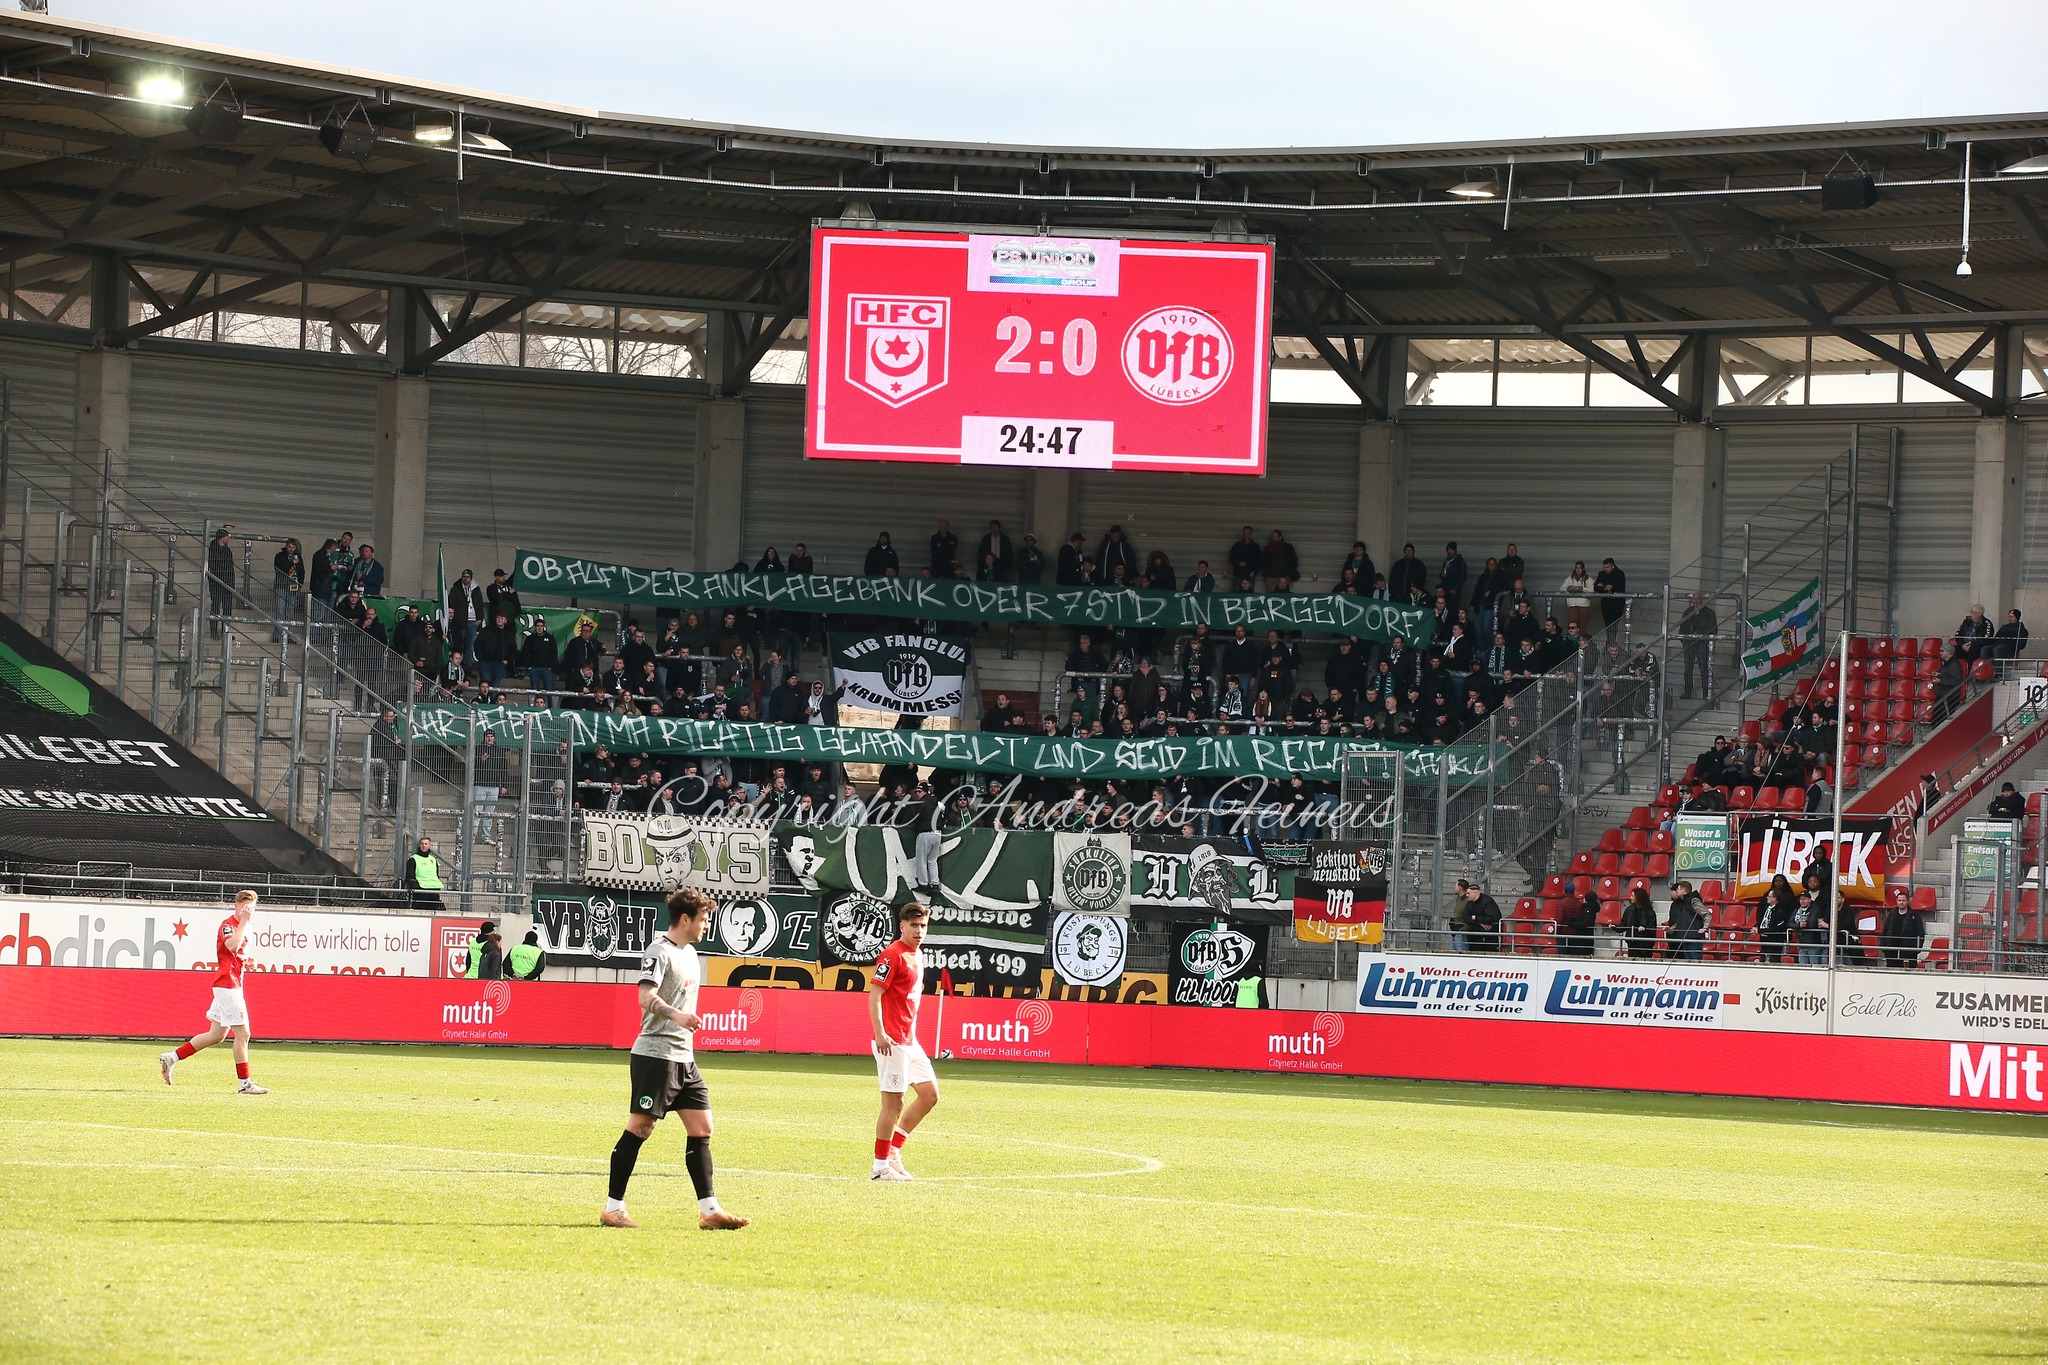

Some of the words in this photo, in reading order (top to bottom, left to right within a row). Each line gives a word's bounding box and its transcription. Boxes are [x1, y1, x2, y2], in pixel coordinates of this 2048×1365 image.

[996, 251, 1022, 262] PS
[1027, 252, 1089, 265] UNION
[860, 303, 937, 324] HFC
[1161, 315, 1197, 326] 1919
[995, 315, 1097, 376] 2:0
[1150, 384, 1201, 399] LÜBECK
[1000, 424, 1082, 454] 24:47
[522, 556, 563, 581] OB
[565, 560, 616, 589] AUF
[622, 566, 700, 599] DER
[703, 573, 946, 608] ANKLAGEBANK
[953, 582, 1054, 621] ODER
[1174, 592, 1212, 626] IN
[843, 638, 880, 659] VfB
[0, 734, 180, 767] ILEBET
[657, 717, 805, 754] RICHTIG
[813, 727, 1029, 766] GEHANDELT
[1034, 741, 1106, 773] UND
[1114, 737, 1188, 773] SEID
[1196, 737, 1241, 771] IM
[33, 789, 267, 818] SPORTWETTE.
[1680, 838, 1726, 849] Entsorgung
[1684, 829, 1714, 838] Wasser
[1715, 829, 1721, 838] &
[928, 903, 1032, 929] rontside
[1307, 914, 1368, 940] LÜBECK
[314, 927, 377, 951] wirklich
[384, 930, 420, 952] tolle
[921, 947, 982, 972] übeck
[1420, 966, 1528, 980] Wohn-Centrum
[1607, 974, 1719, 987] Wohn-Centrum
[1360, 962, 1529, 1009] Lührmann
[1544, 969, 1720, 1016] Lührmann
[442, 1001, 493, 1024] muth
[1446, 1002, 1471, 1011] der
[1474, 1003, 1523, 1013] Saline
[1755, 986, 1827, 1016] Köstritze
[1841, 993, 1883, 1018] Edel
[1879, 993, 1918, 1018] Pils
[1936, 991, 2048, 1014] ZUSAMME
[702, 1009, 747, 1031] muth
[1634, 1010, 1660, 1019] der
[1663, 1011, 1714, 1022] Saline
[1962, 1015, 2011, 1029] WIRD'S
[441, 1028, 468, 1040] Citynetz
[469, 1029, 486, 1039] Halle
[487, 1030, 508, 1039] GmbH
[701, 1036, 727, 1046] Citynetz
[728, 1036, 742, 1046] Halle
[743, 1037, 760, 1046] GmbH
[962, 1020, 1029, 1043] muth
[961, 1045, 997, 1057] Citynetz
[999, 1046, 1021, 1057] Halle
[1023, 1048, 1051, 1058] GmbH
[1269, 1032, 1325, 1055] muth
[1268, 1058, 1297, 1069] Citynetz
[1300, 1060, 1318, 1069] Halle
[1320, 1061, 1343, 1070] GmbH
[1949, 1043, 2043, 1102] Mit
